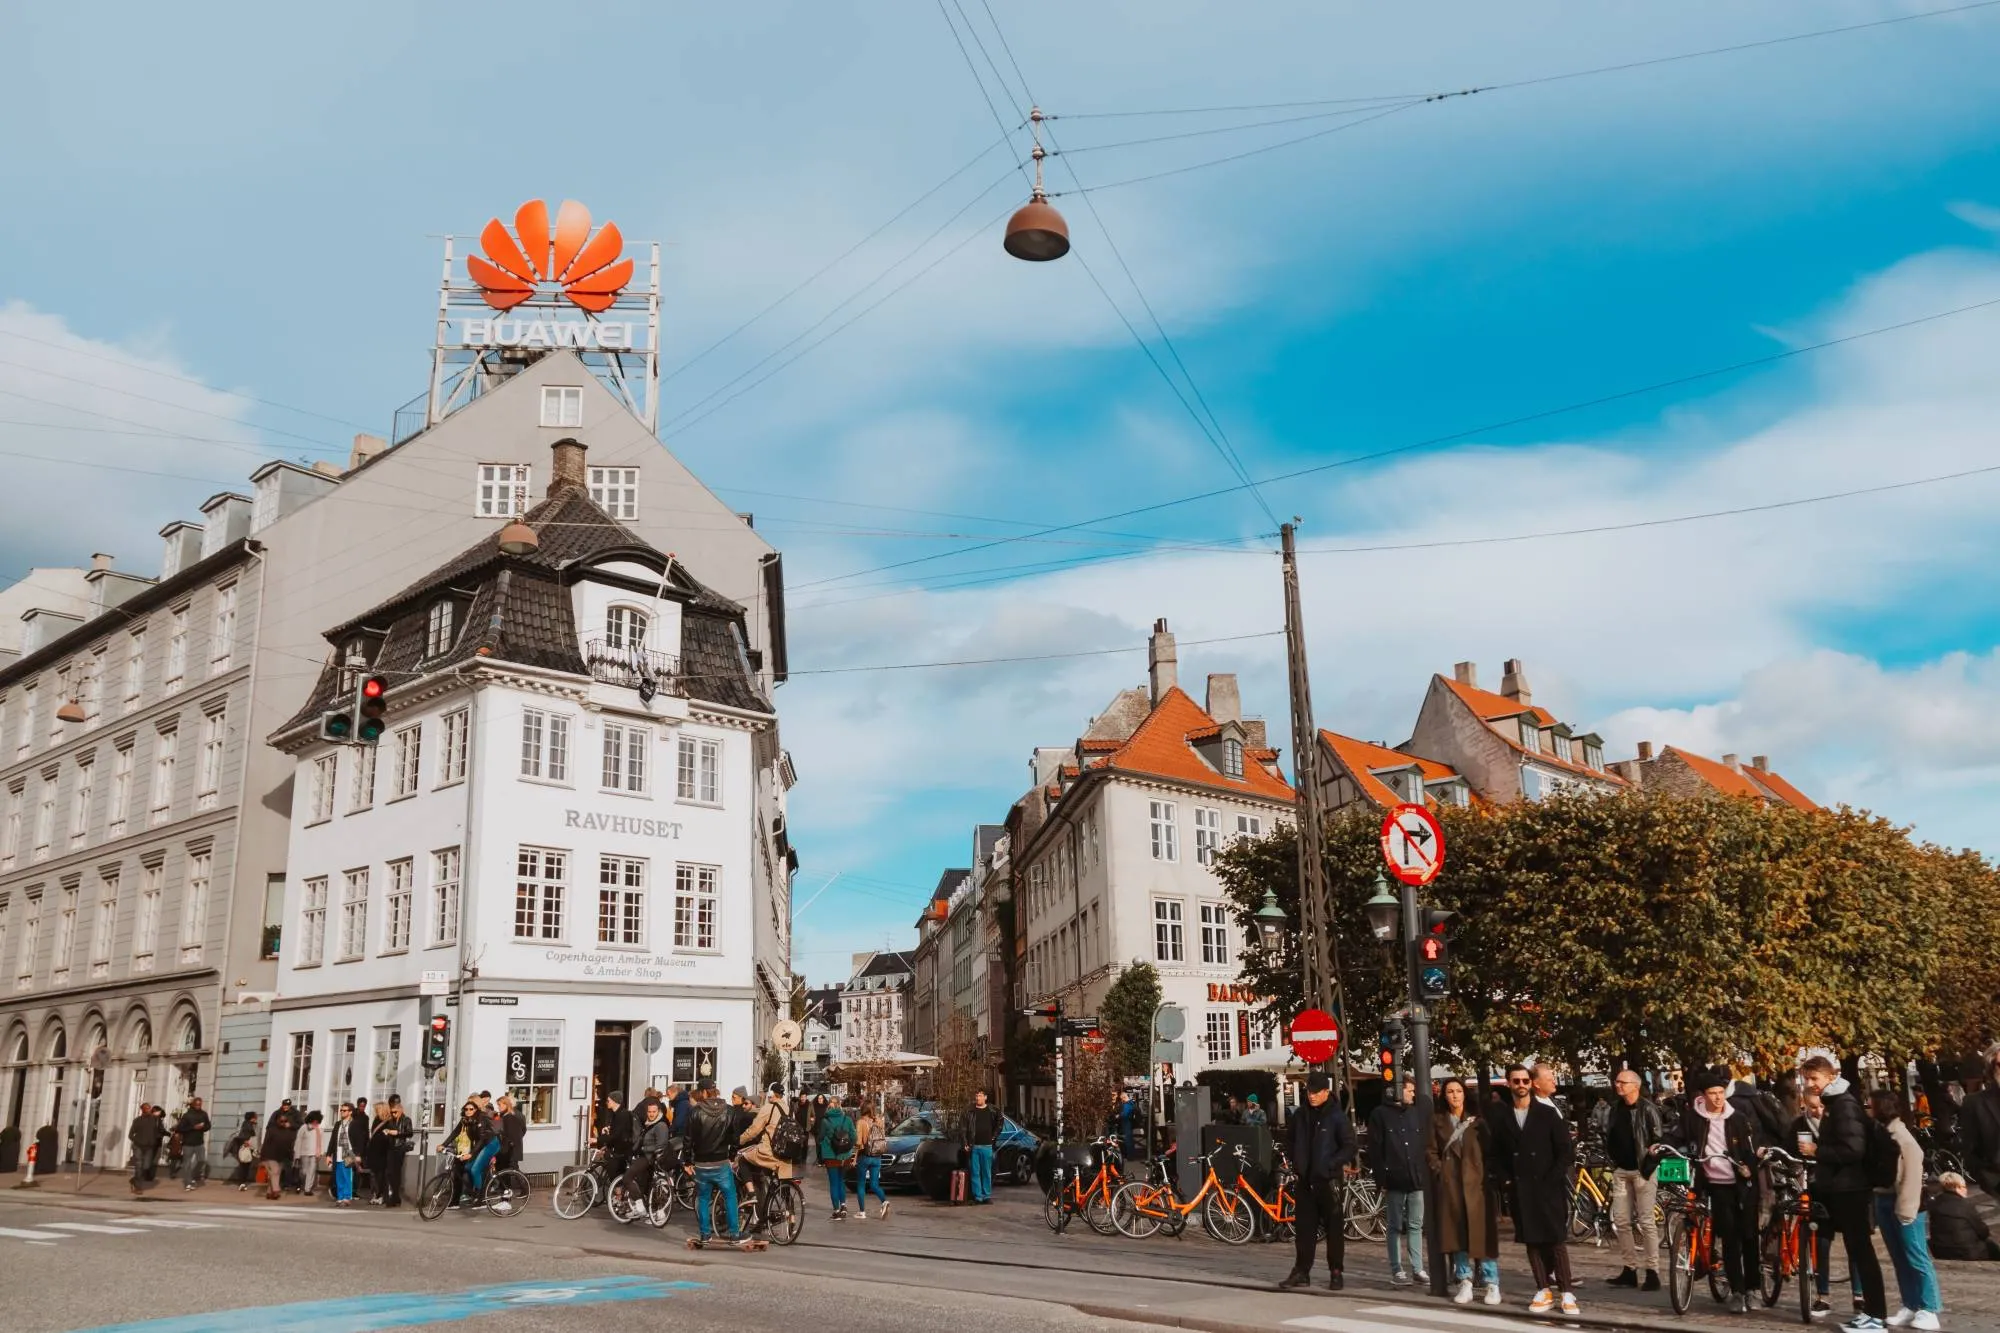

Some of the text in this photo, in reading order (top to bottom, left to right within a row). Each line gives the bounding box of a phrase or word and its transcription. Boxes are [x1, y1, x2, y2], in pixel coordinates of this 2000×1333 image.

[462, 318, 632, 348] HUAWEI
[565, 809, 683, 840] RAVHUSET
[545, 950, 697, 968] Copenhagen Amber Museum
[583, 965, 662, 980] & Amber Shop
